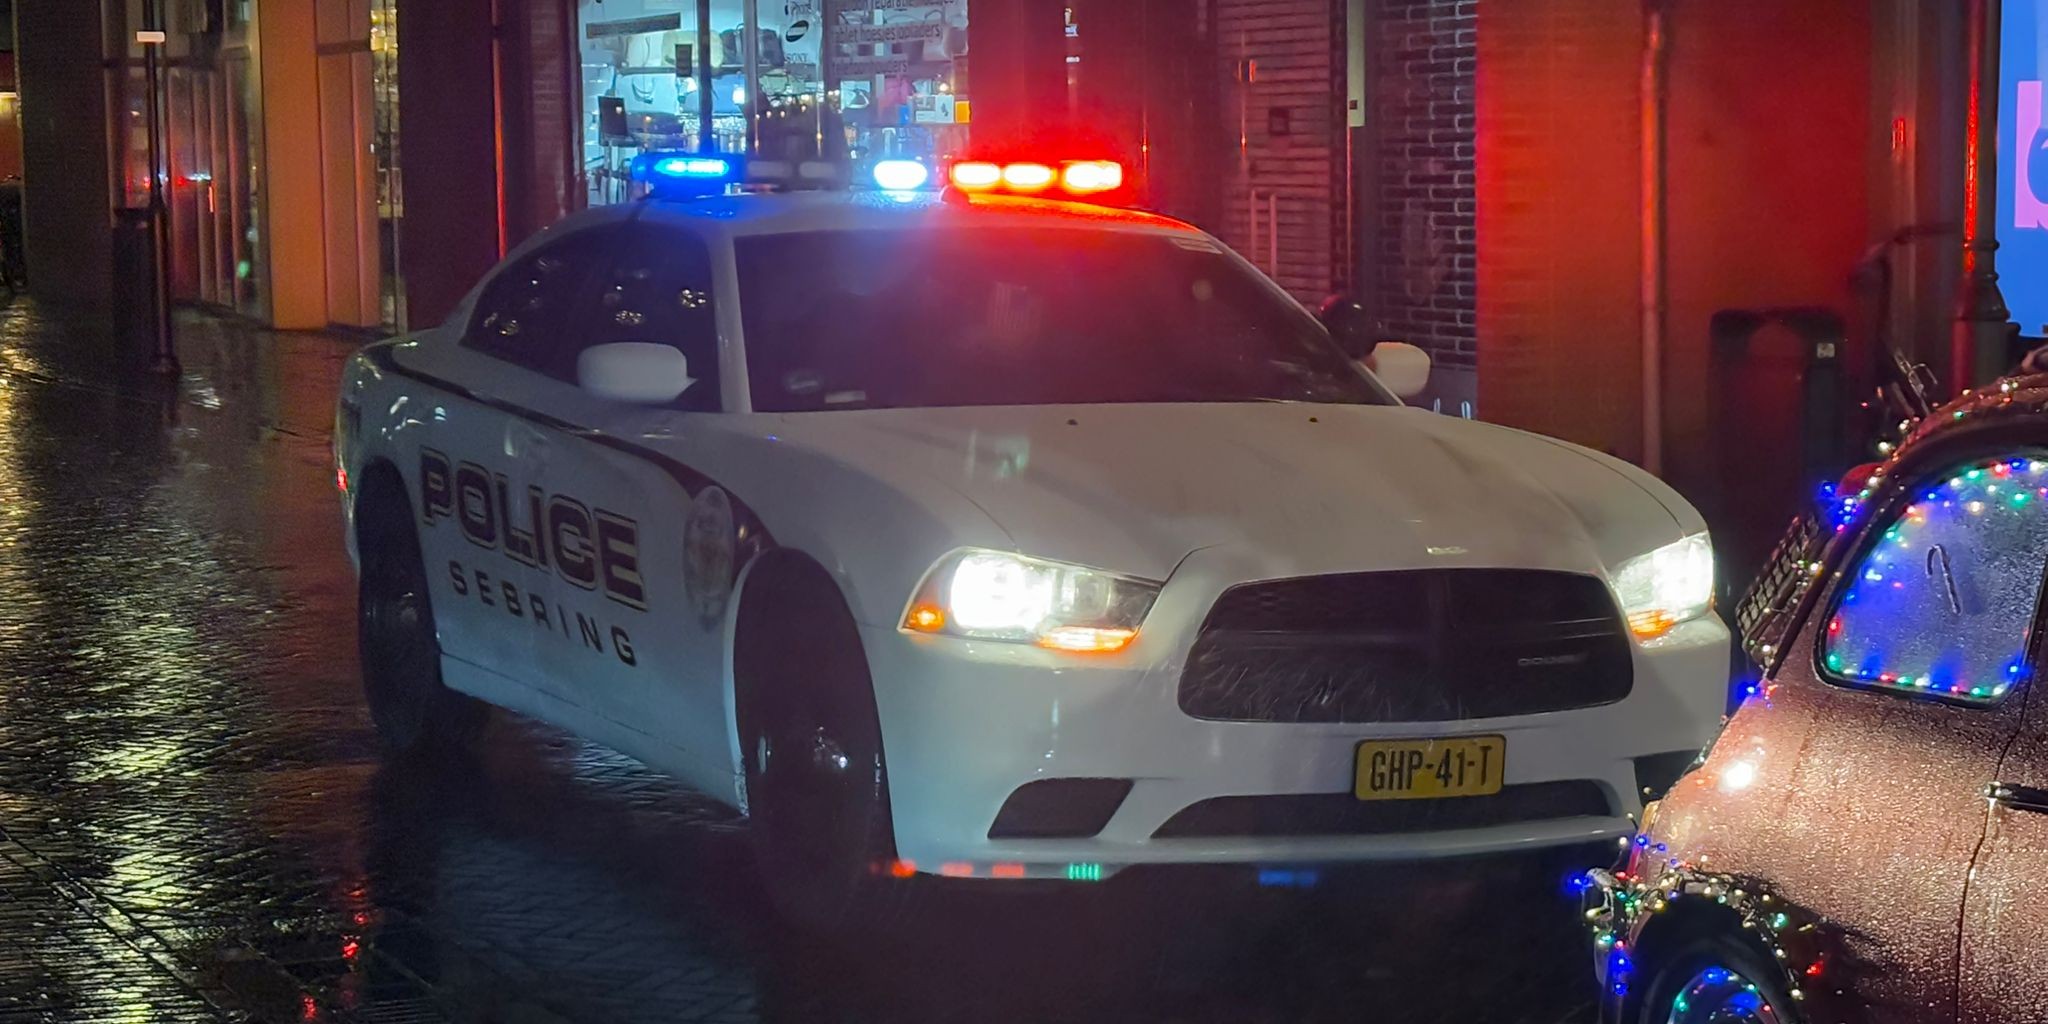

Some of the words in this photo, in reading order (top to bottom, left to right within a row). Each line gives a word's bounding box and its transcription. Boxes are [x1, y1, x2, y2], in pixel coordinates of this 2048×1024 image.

[420, 446, 648, 612] POLICE
[448, 560, 637, 667] SEBRING
[1370, 745, 1493, 792] GHP-41-T
